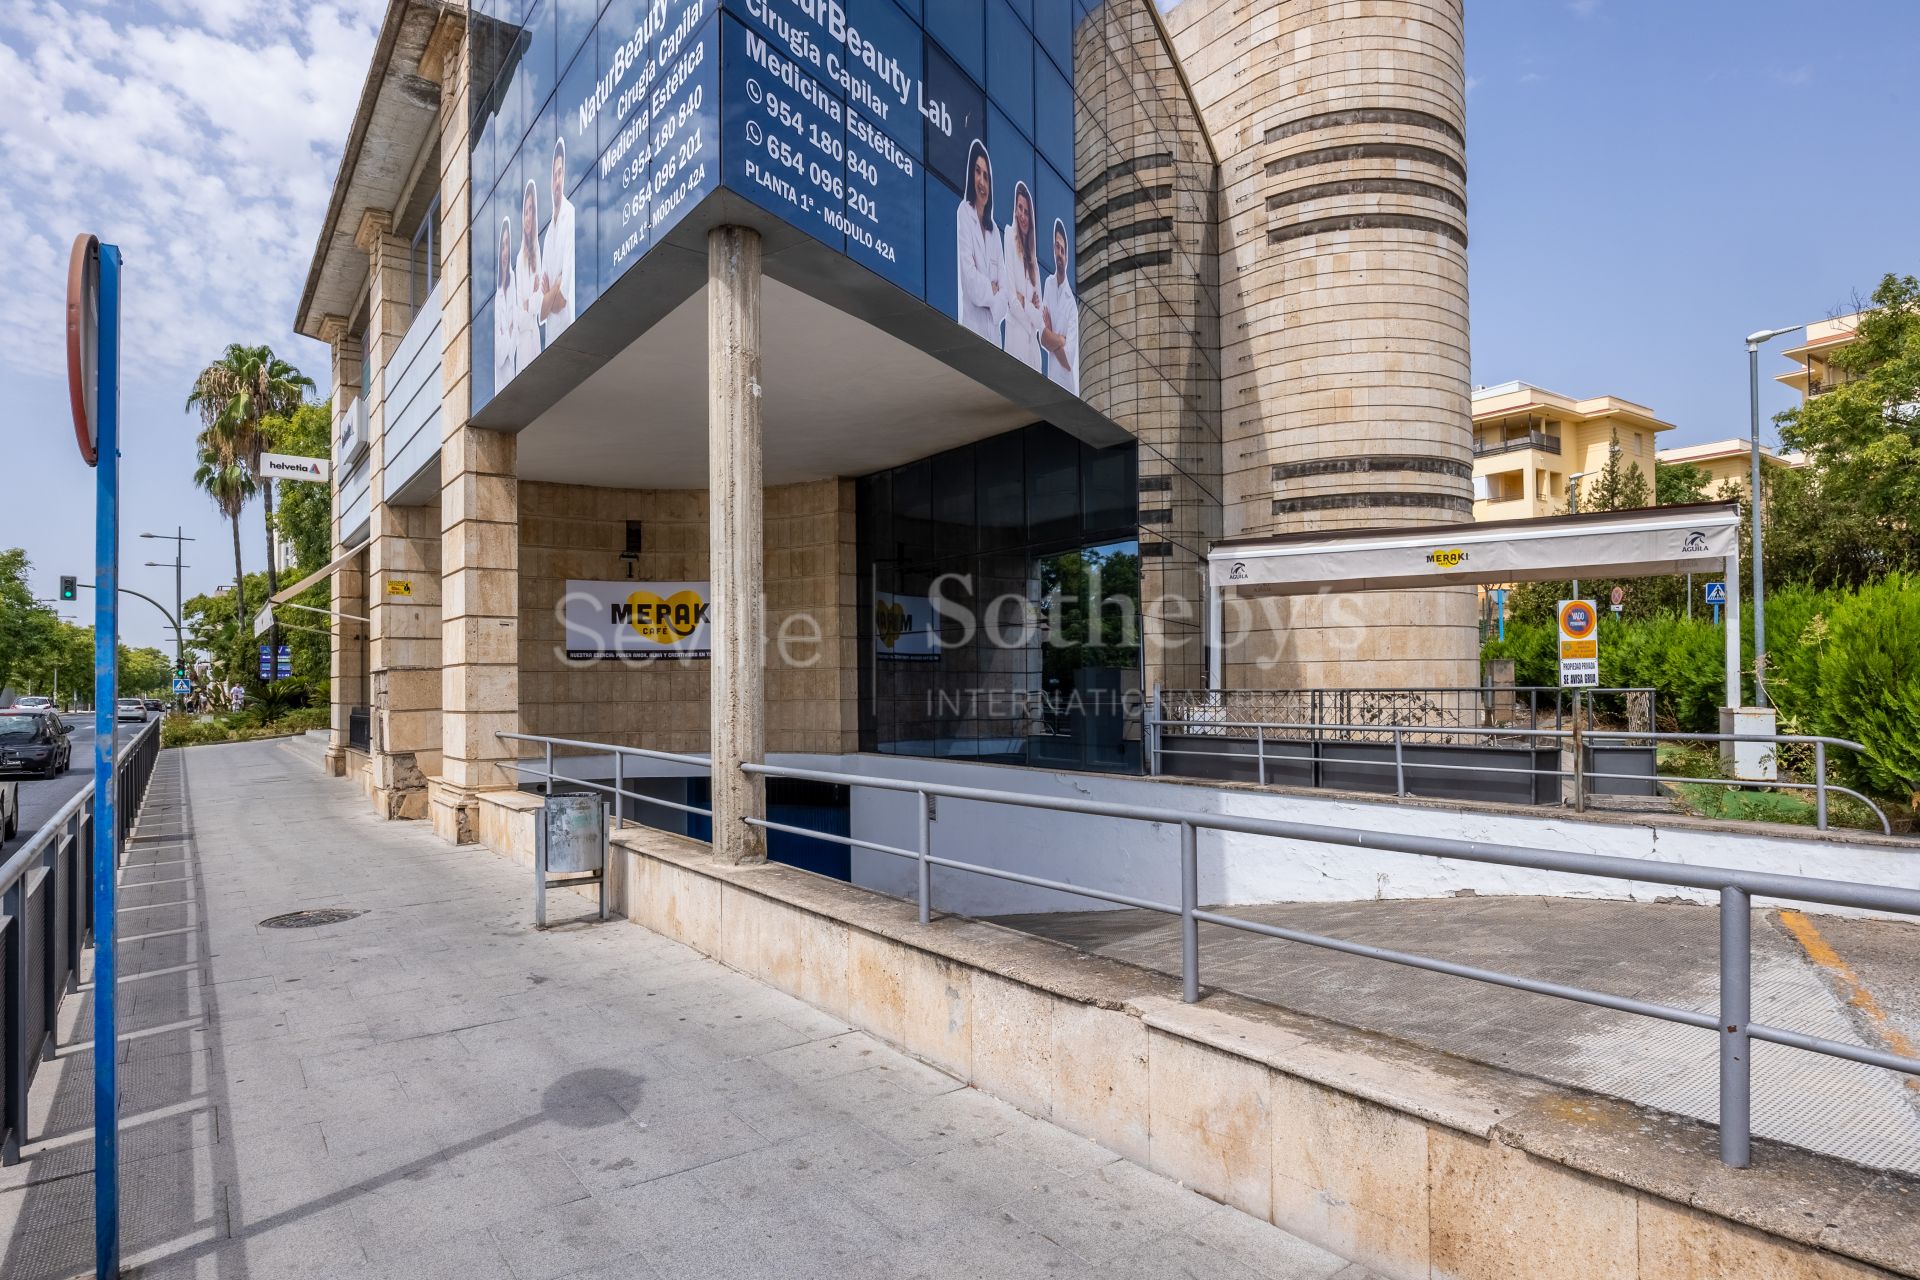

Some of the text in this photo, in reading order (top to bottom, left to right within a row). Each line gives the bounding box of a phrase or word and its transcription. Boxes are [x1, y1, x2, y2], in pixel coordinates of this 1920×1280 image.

[579, 0, 667, 136] NaturBeauty
[601, 41, 704, 180] Medicina Estética
[617, 0, 703, 121] Cirugía Capilar
[746, 0, 889, 121] Cirugía Capilar
[746, 28, 914, 178] Medicina Estética
[792, 0, 953, 137] urBeauty Lab
[631, 84, 703, 181] 954 180 840
[631, 127, 703, 217] 654 096 201
[766, 92, 878, 187] 954 180 840
[767, 134, 879, 224] 654 096 201
[613, 231, 639, 267] PLANTA
[652, 182, 686, 229] MÓDULO
[687, 162, 706, 192] 42A
[745, 159, 798, 206] PLANTA
[824, 206, 873, 249] MÓDULO
[875, 238, 896, 263] 42A
[269, 461, 308, 472] helvetia
[1426, 552, 1469, 564] MERAKI
[611, 602, 711, 626] MERAK
[1570, 674, 1584, 685] AVISA
